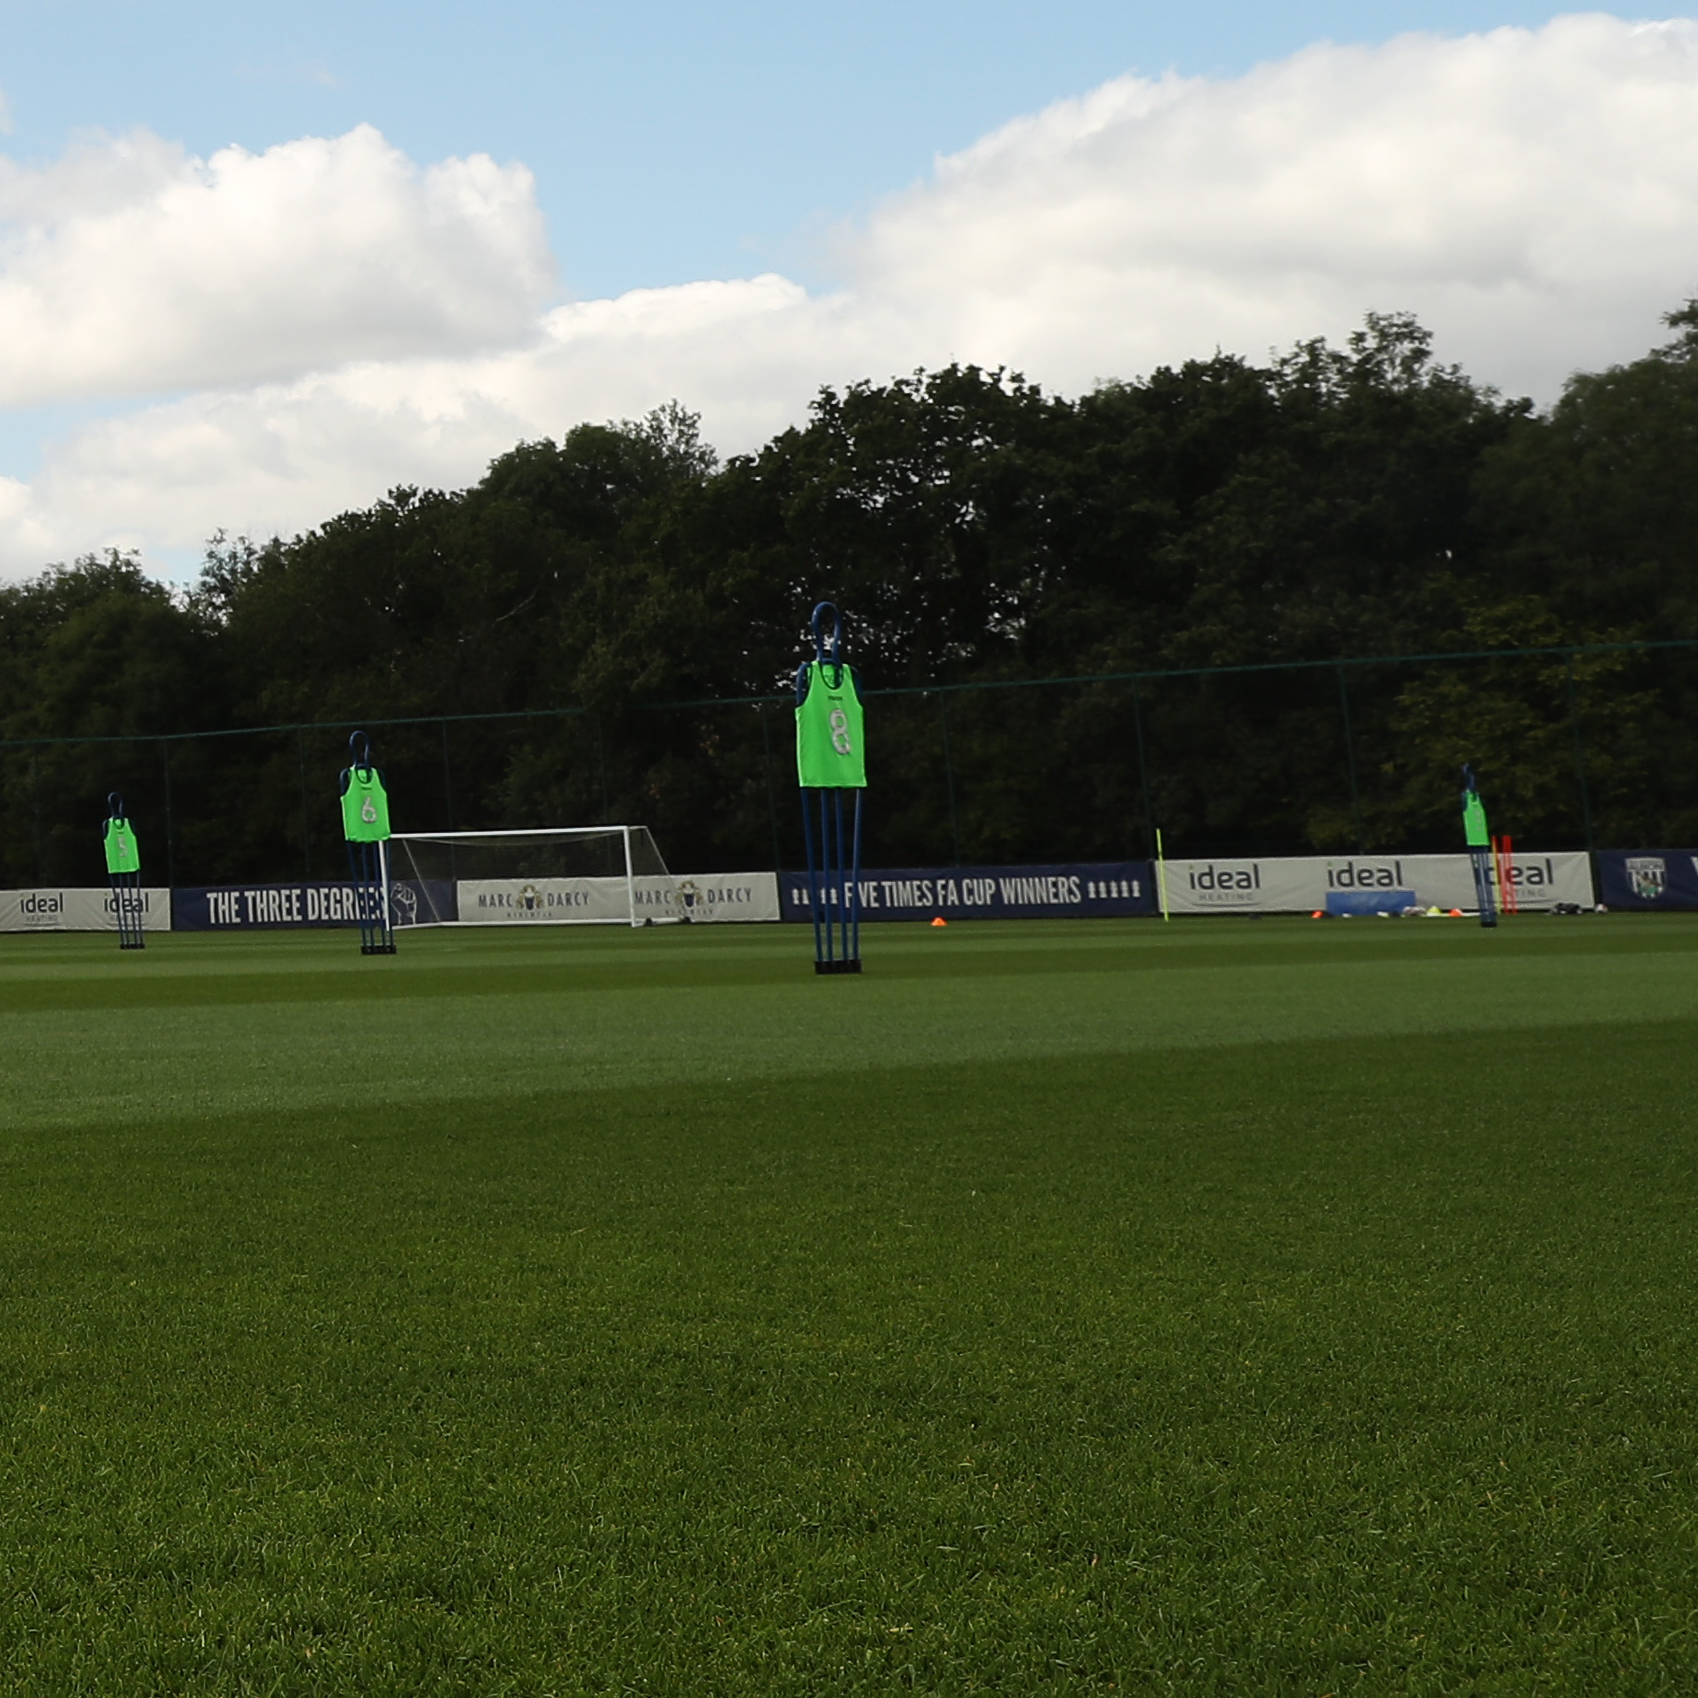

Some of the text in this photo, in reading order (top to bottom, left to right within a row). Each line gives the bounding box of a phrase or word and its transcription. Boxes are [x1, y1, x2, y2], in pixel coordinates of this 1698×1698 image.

[830, 708, 851, 755] 8
[361, 796, 377, 823] 6
[117, 836, 129, 858] 5
[1189, 863, 1260, 890] ideal
[1327, 861, 1403, 888] ideal
[21, 893, 63, 914] ideal
[478, 891, 589, 908] MARC DARCY
[635, 888, 752, 905] MARC DARCY
[844, 876, 1082, 908] FVE TIMES FA CUP WINNERS
[207, 891, 241, 924] THE
[244, 889, 303, 922] THREE
